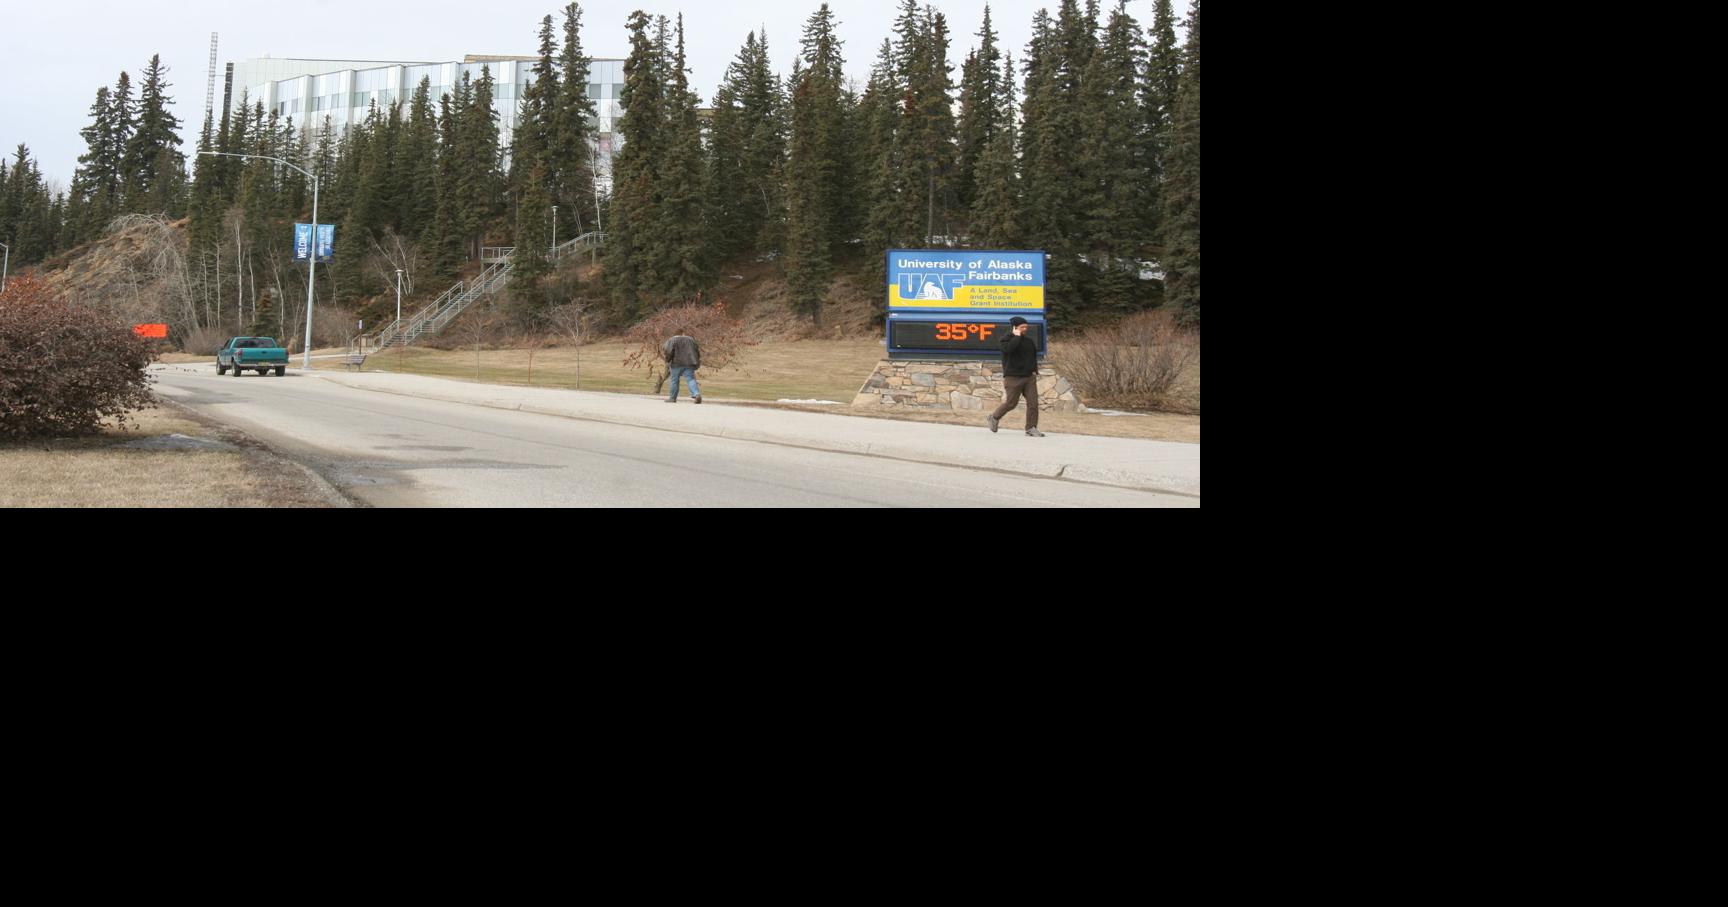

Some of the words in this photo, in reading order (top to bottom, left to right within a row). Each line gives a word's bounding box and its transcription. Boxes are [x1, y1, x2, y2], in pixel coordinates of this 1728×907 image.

[898, 259, 963, 270] University
[968, 260, 982, 269] of
[988, 260, 1032, 269] Alaska
[968, 271, 1033, 281] Fairbanks
[898, 273, 966, 300] UAF
[936, 323, 996, 341] 35°F
